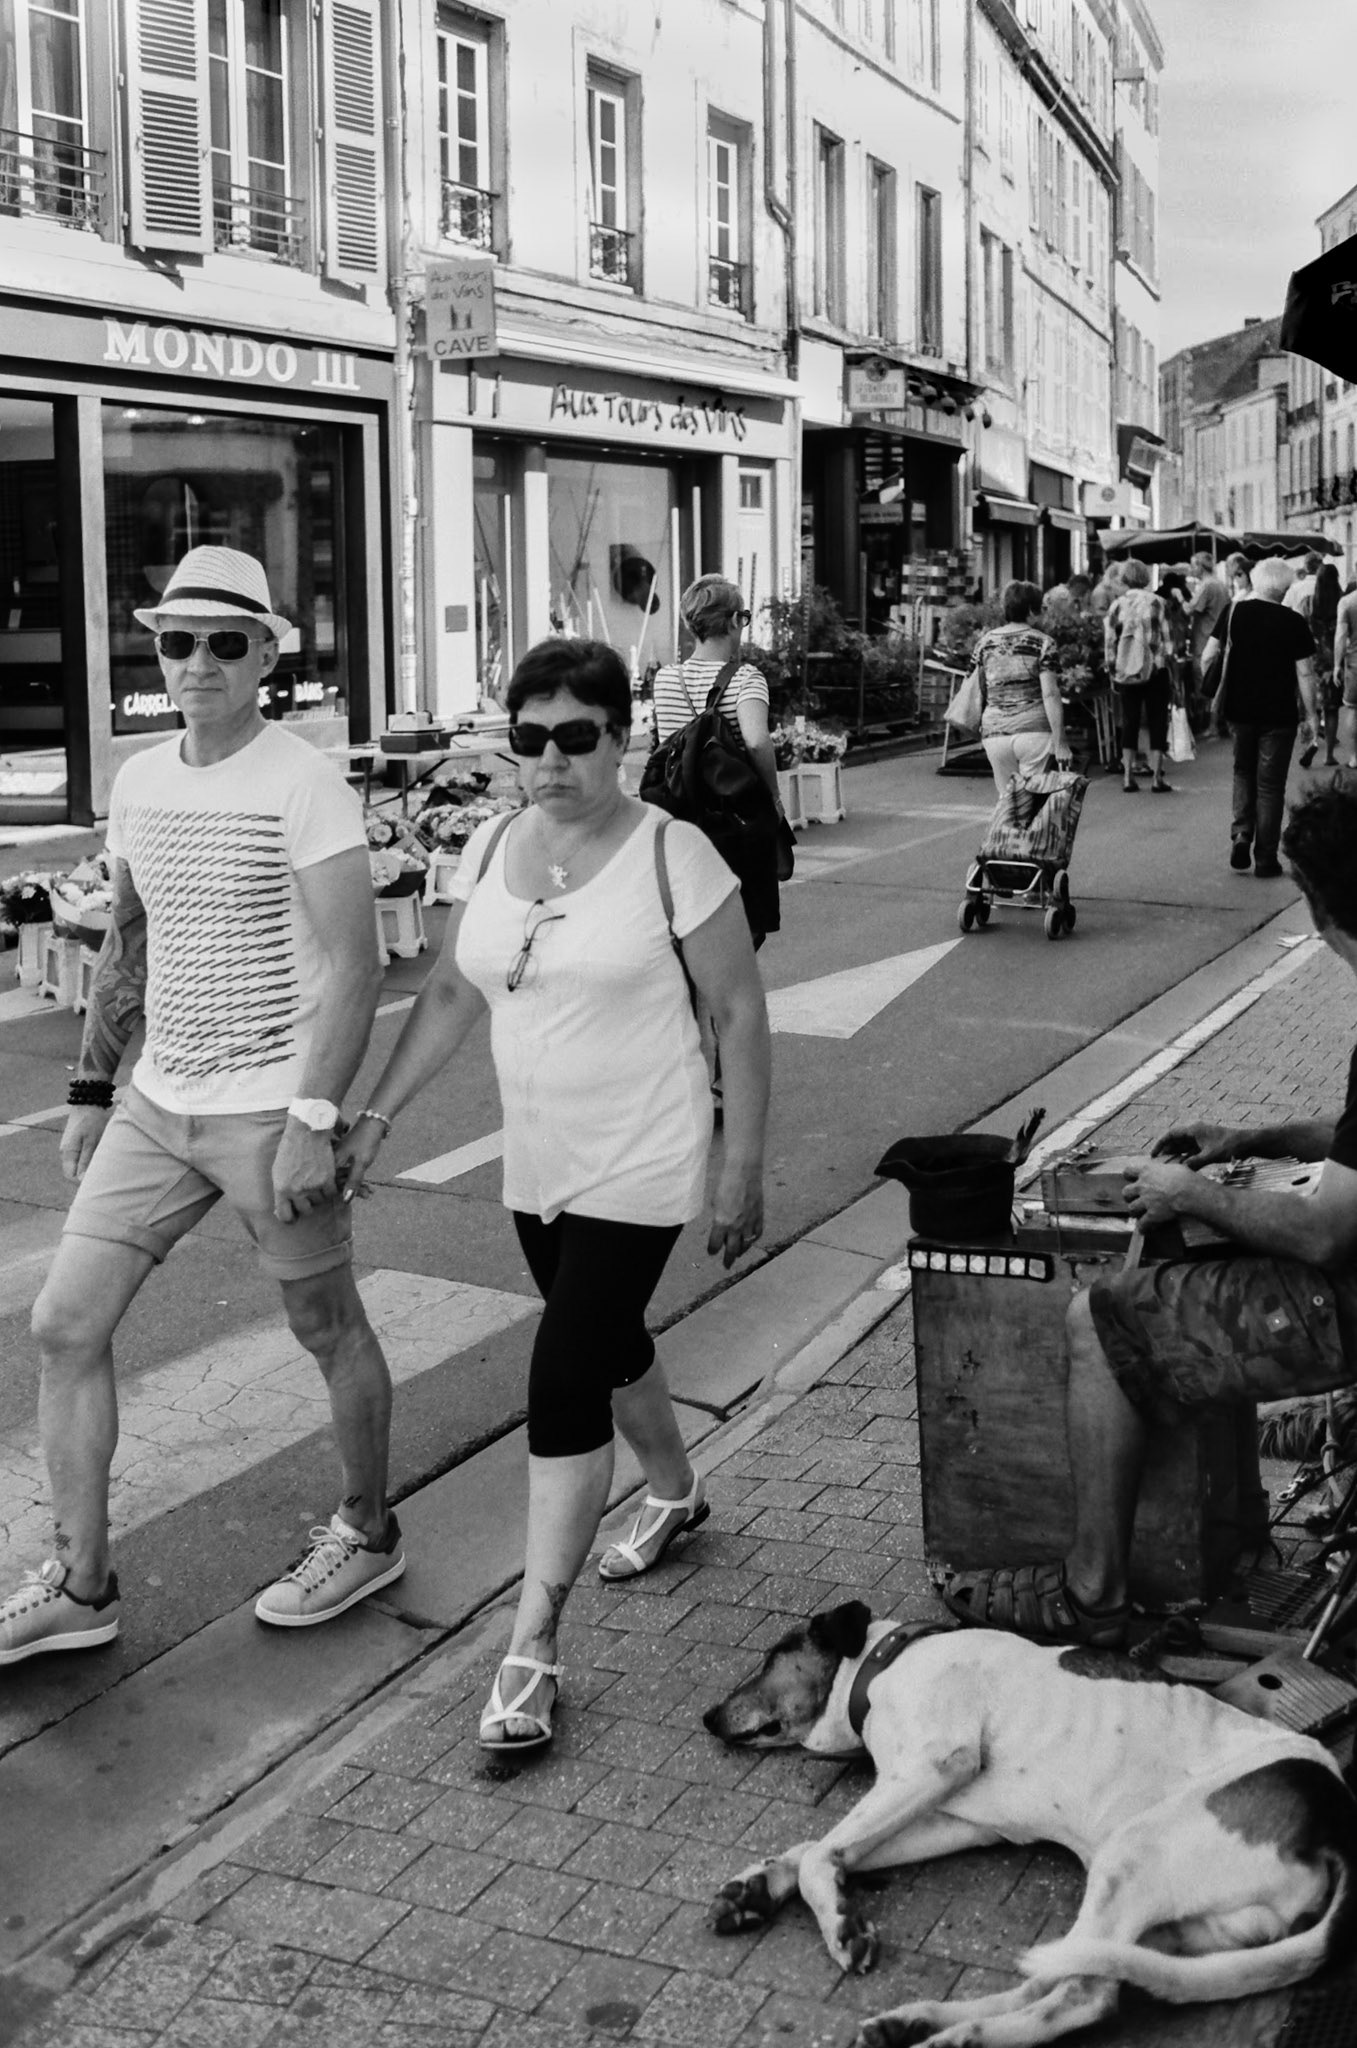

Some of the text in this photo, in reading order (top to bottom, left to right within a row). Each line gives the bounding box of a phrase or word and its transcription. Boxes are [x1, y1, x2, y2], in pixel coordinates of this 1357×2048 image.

[103, 316, 361, 391] MONDO III
[434, 335, 489, 356] CAVE
[549, 382, 598, 421] Aux
[123, 691, 180, 717] CARREL
